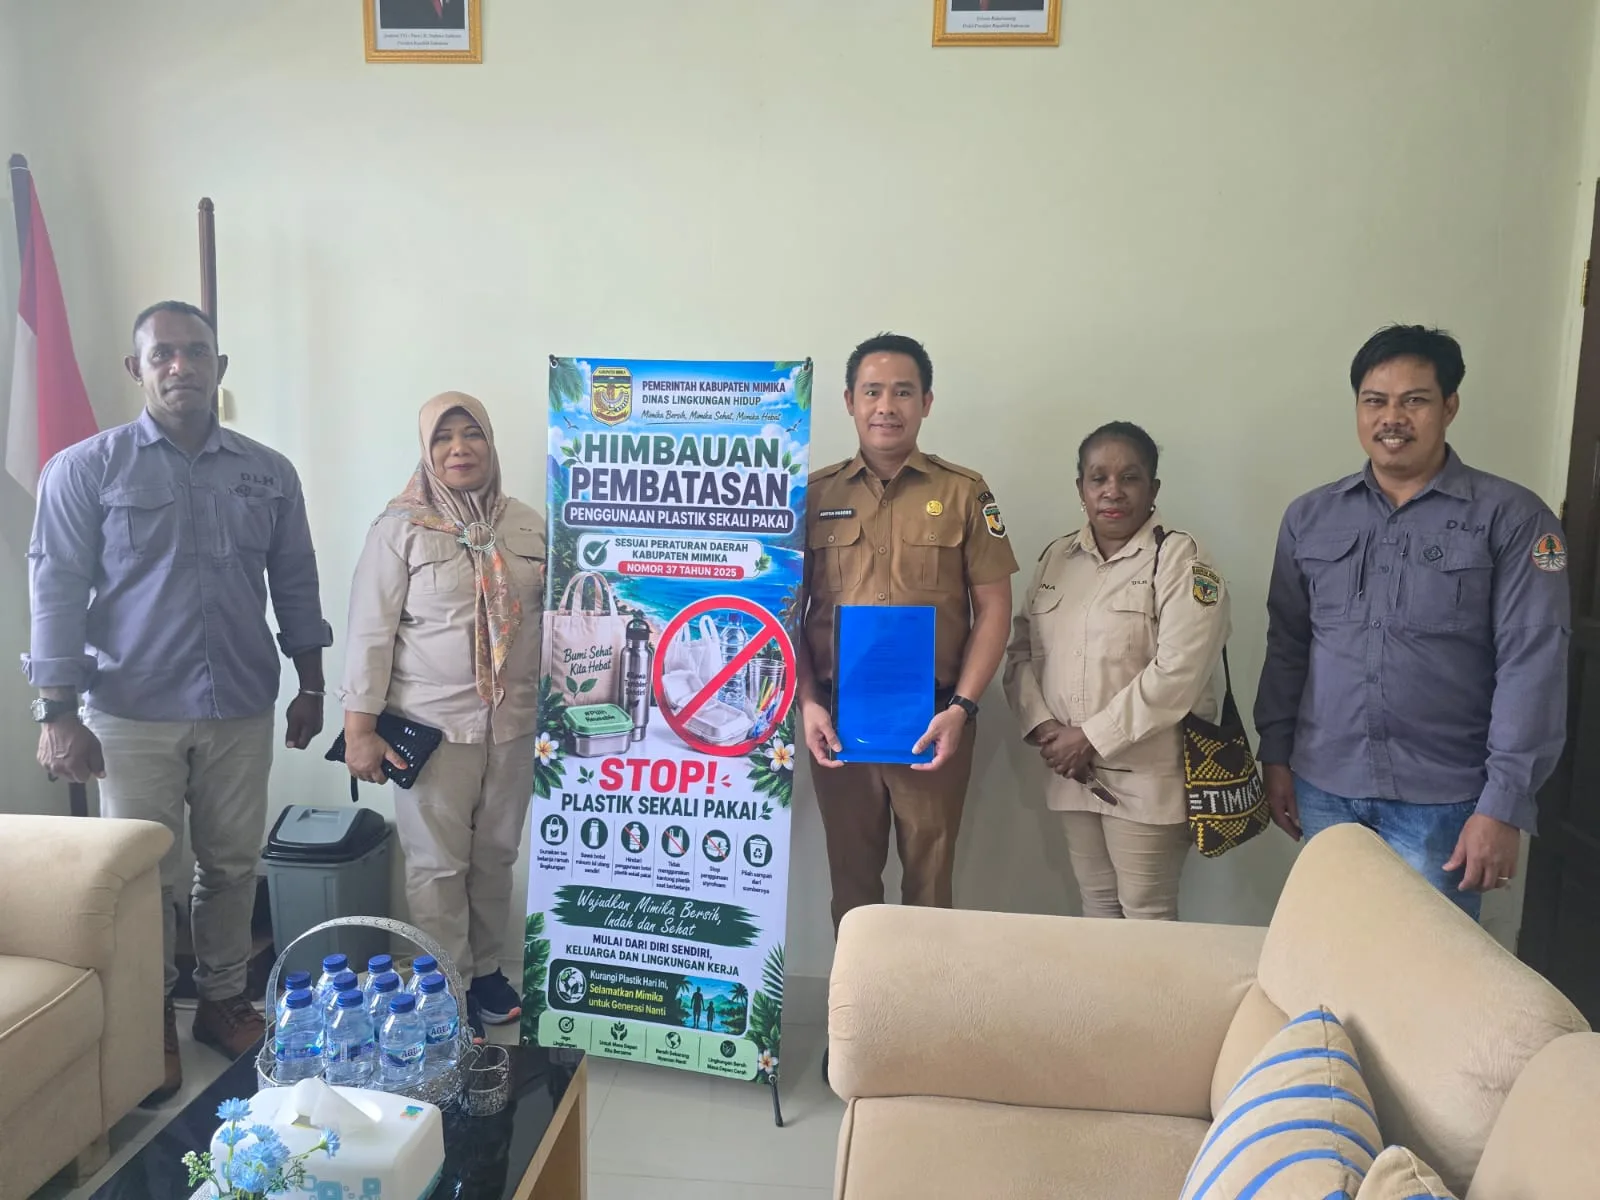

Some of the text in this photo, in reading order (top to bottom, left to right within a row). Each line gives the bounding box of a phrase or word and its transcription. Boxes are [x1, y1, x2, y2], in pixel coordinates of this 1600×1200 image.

[642, 380, 786, 393] PEMERINTAH KABUPATEN MIMIKA
[642, 394, 762, 406] DINAS LINGKUNGAN HIDUP
[641, 409, 782, 421] Mimika Bersih, Mimika Sehat, Mimika Hebat
[584, 433, 780, 468] HIMBAUAN
[571, 467, 789, 507] PEMBATASAN
[570, 507, 789, 529] PENGGUNAAN PLASTIK SEKALI PAKAI
[1445, 519, 1486, 537] DLH
[615, 538, 749, 552] SESUAI PERATURAN DAERAH
[632, 550, 728, 563] KABUPATEN MIMIKA
[627, 563, 737, 578] NOMOR 37 TAHUN 2025
[563, 644, 613, 663] Bumi Sehat
[570, 659, 612, 676] Kita Hebat
[599, 757, 718, 795] STOP!
[561, 793, 758, 820] PLASTIK SEKALI PAKAI
[577, 889, 722, 925] Wujudkan Mimika Bersih,
[603, 910, 697, 936] Indah dan Sehat
[592, 934, 713, 960] MULAI DARI DIRI SENDIRI,
[565, 944, 739, 976] KELUARGA DAN LINGKUNGAN KERJA
[590, 969, 669, 991] Kurangi Plastik Hari Ini,
[589, 983, 664, 1003] Selamatkan Mimika
[588, 998, 667, 1016] untuk Generasi Nanti
